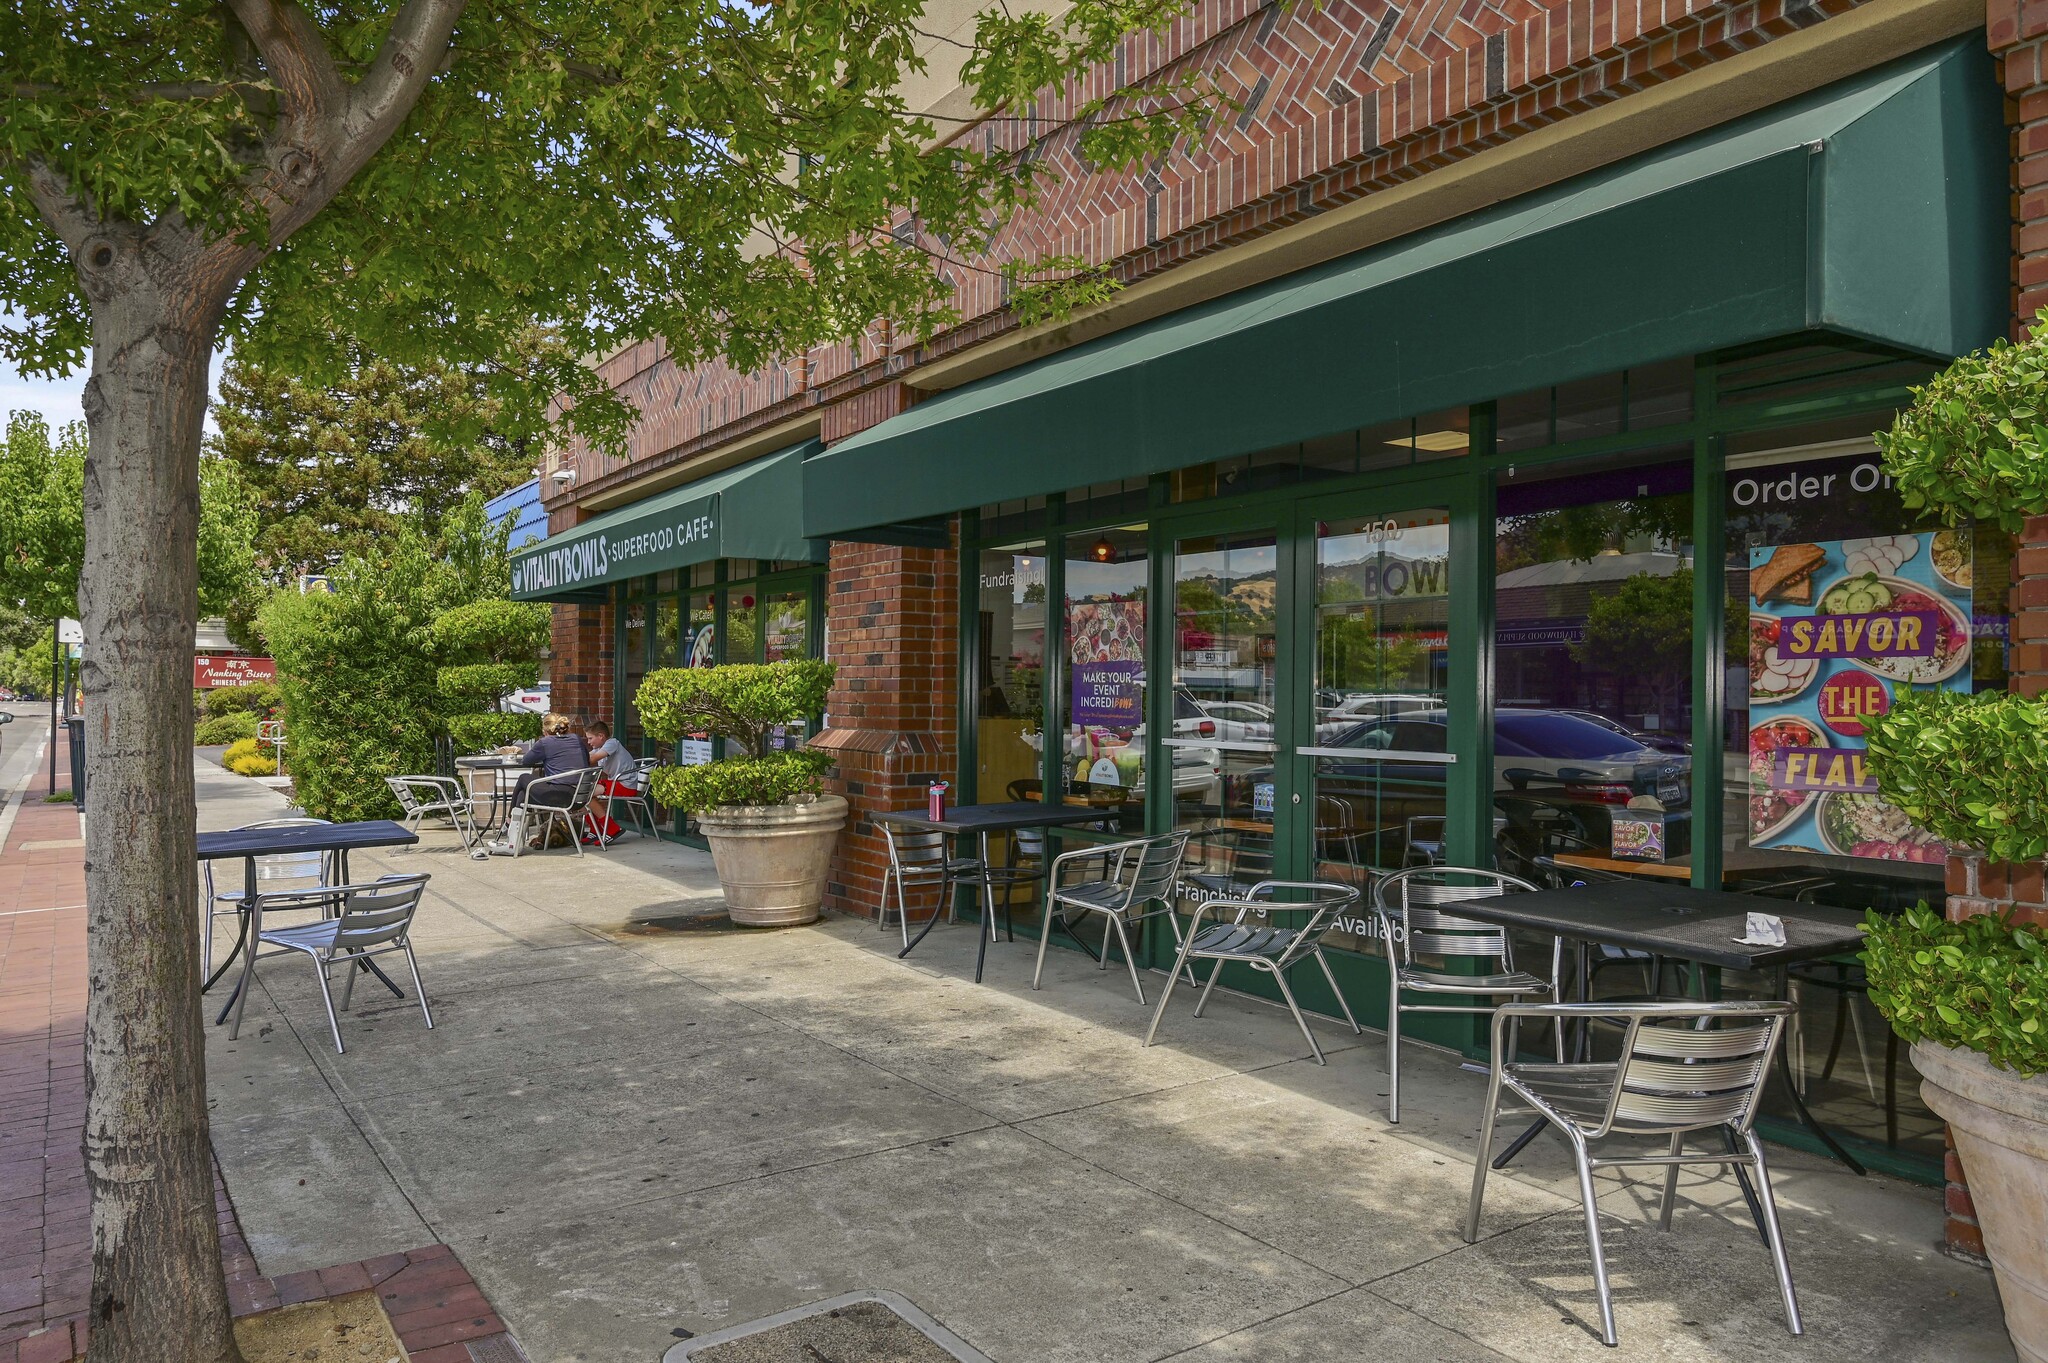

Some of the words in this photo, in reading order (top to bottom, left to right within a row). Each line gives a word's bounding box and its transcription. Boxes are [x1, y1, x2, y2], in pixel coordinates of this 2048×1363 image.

[1733, 472, 1836, 506] Order
[1362, 519, 1398, 543] 150
[522, 535, 608, 592] VITALITYBOWLS
[612, 527, 673, 562] SUPERFOOD
[677, 516, 709, 546] CAFE
[1789, 616, 1922, 654] SAVOR
[197, 658, 209, 666] 150
[202, 668, 242, 680] Nanking
[244, 669, 272, 678] Bistro
[1083, 672, 1106, 682] MAKE
[1108, 672, 1131, 683] YOUR
[1094, 685, 1120, 695] EVENT
[1823, 686, 1880, 715] THE
[1785, 753, 1870, 787] FLAV
